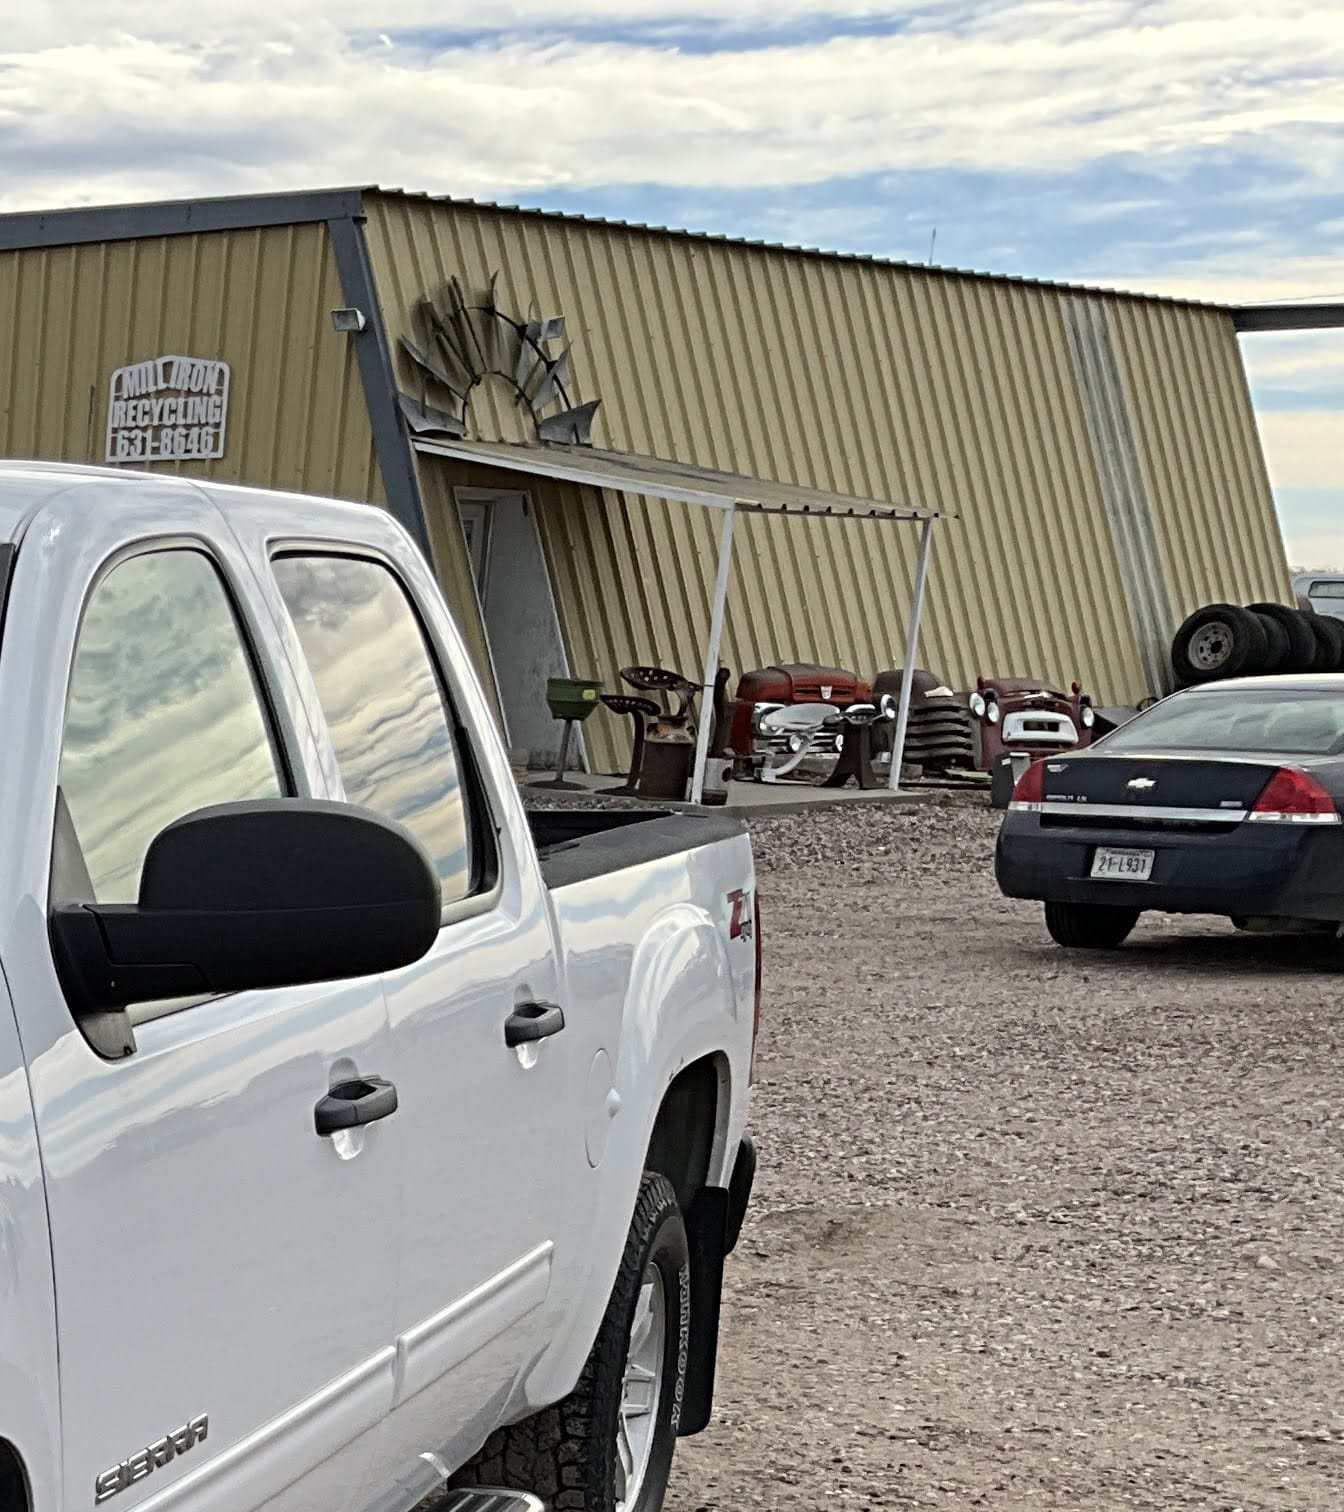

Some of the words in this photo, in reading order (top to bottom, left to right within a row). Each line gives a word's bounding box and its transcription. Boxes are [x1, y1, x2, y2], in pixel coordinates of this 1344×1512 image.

[122, 360, 169, 399] MILL
[169, 360, 219, 394] IRON
[112, 395, 223, 428] RECYCLING
[116, 426, 213, 456] 631-8646
[95, 1413, 209, 1506] SIERRA
